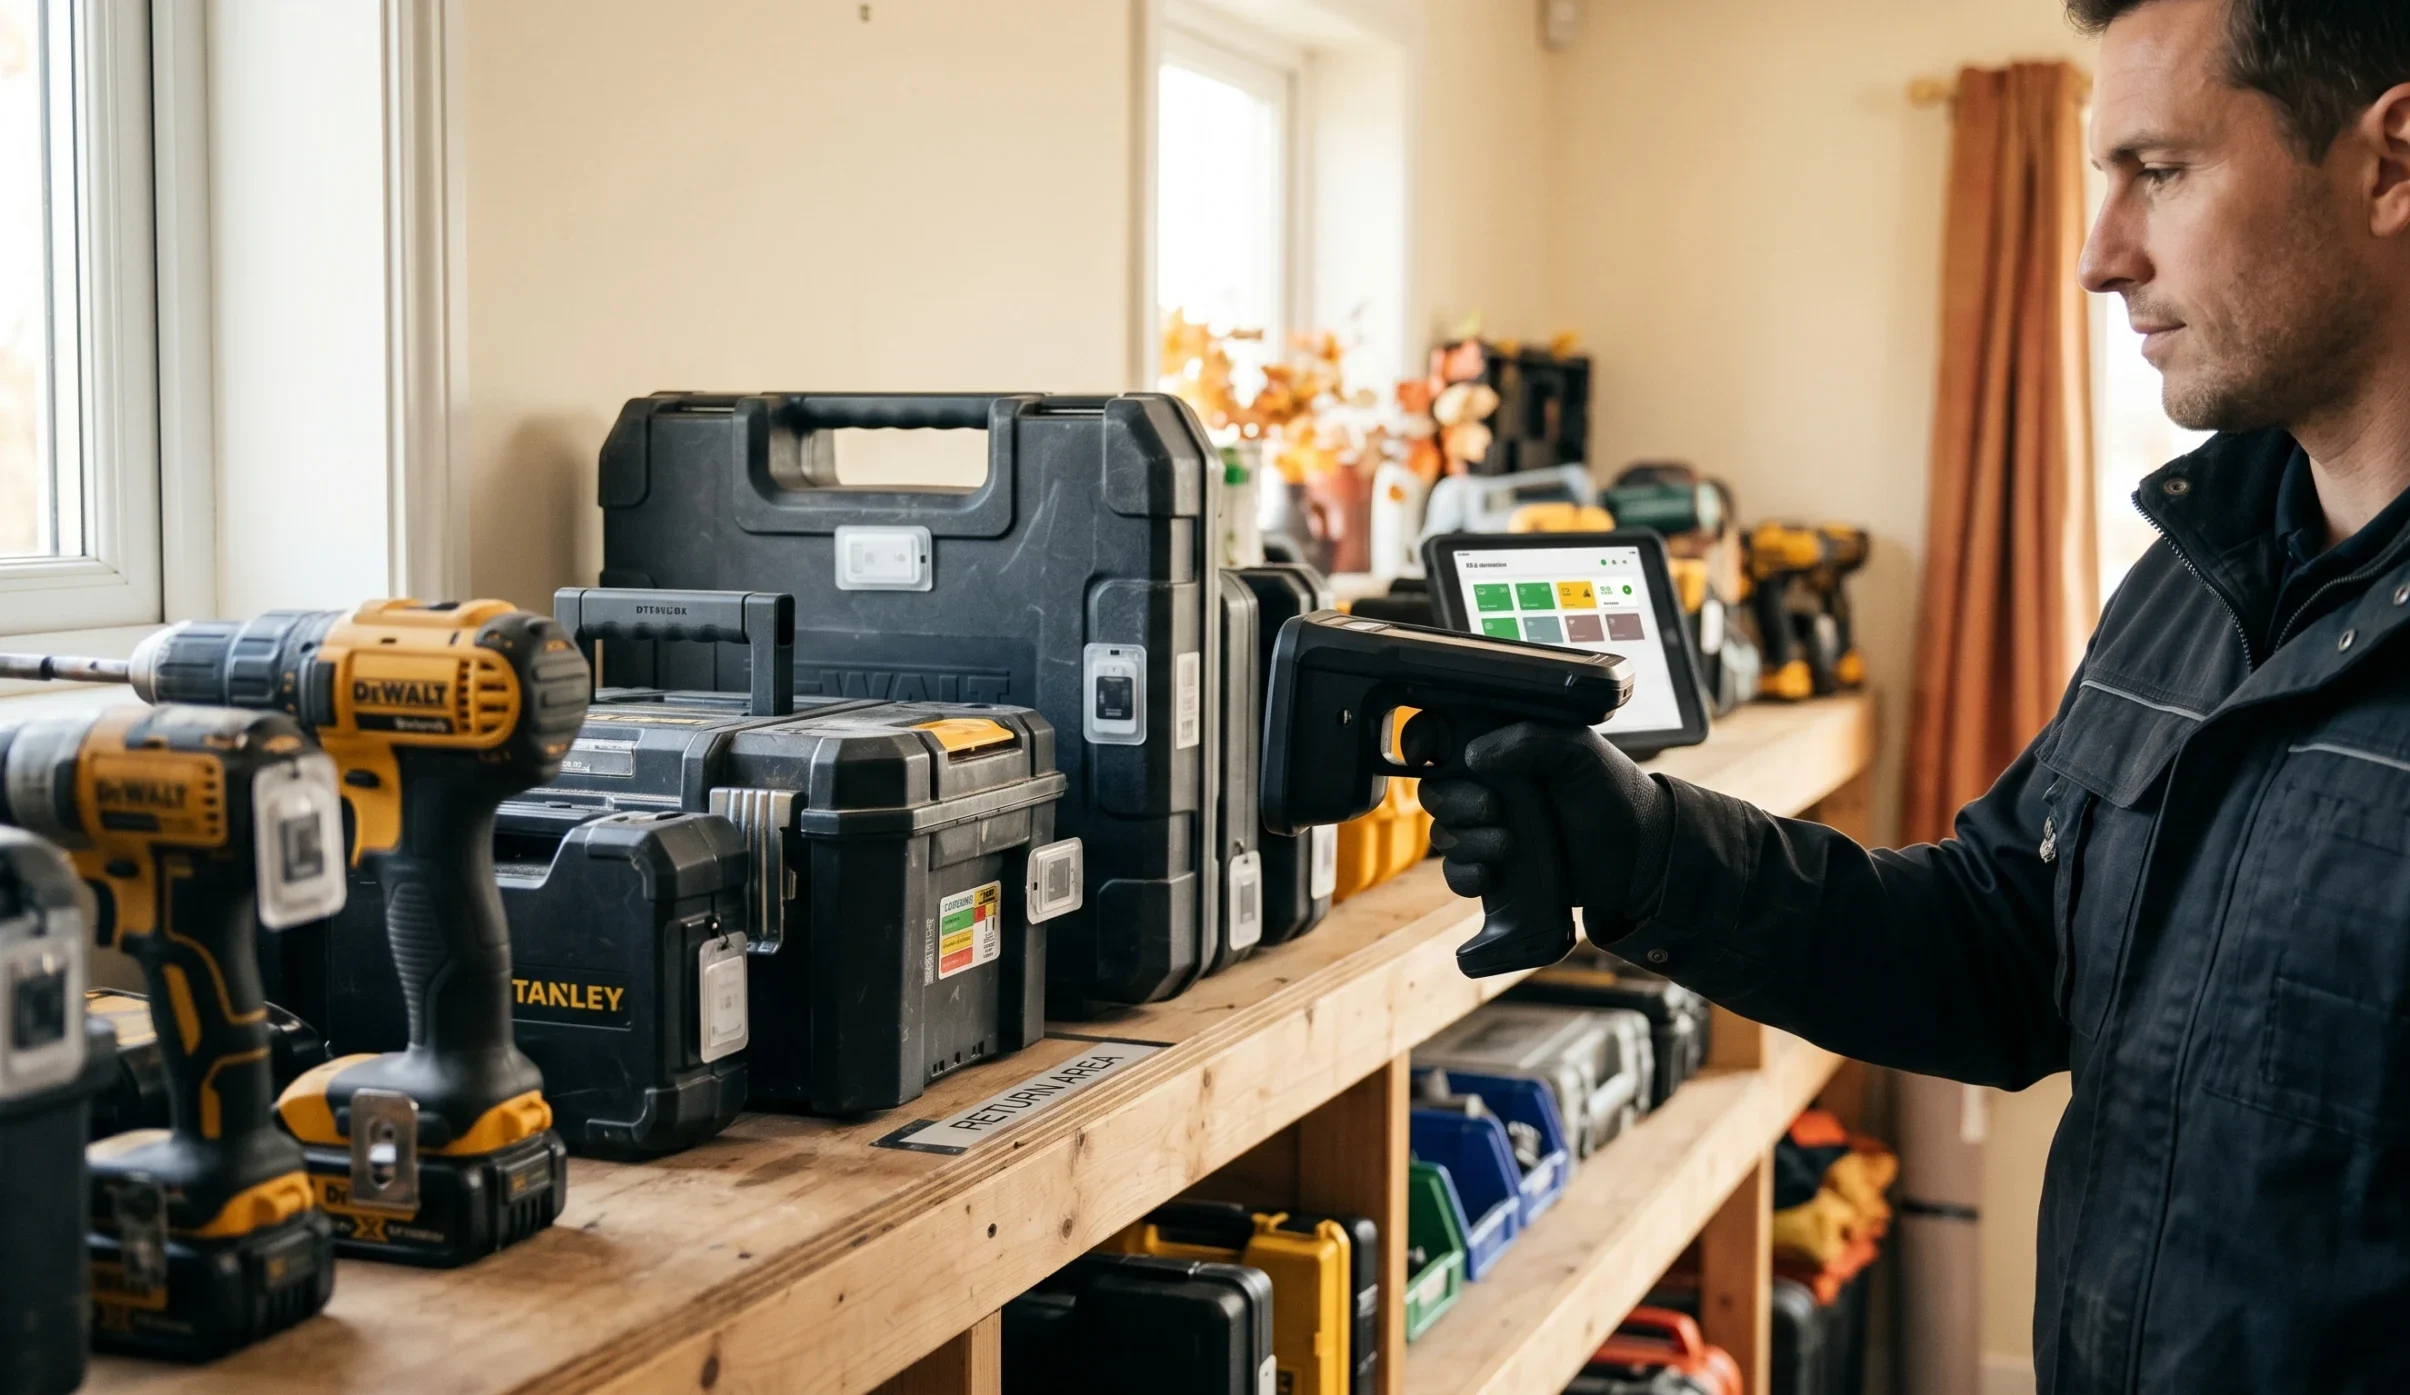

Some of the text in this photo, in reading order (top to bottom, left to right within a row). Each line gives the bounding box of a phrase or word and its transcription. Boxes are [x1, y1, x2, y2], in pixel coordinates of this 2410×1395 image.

[511, 979, 624, 1012] TANLEY
[949, 1056, 1124, 1131] RETURN AREA
